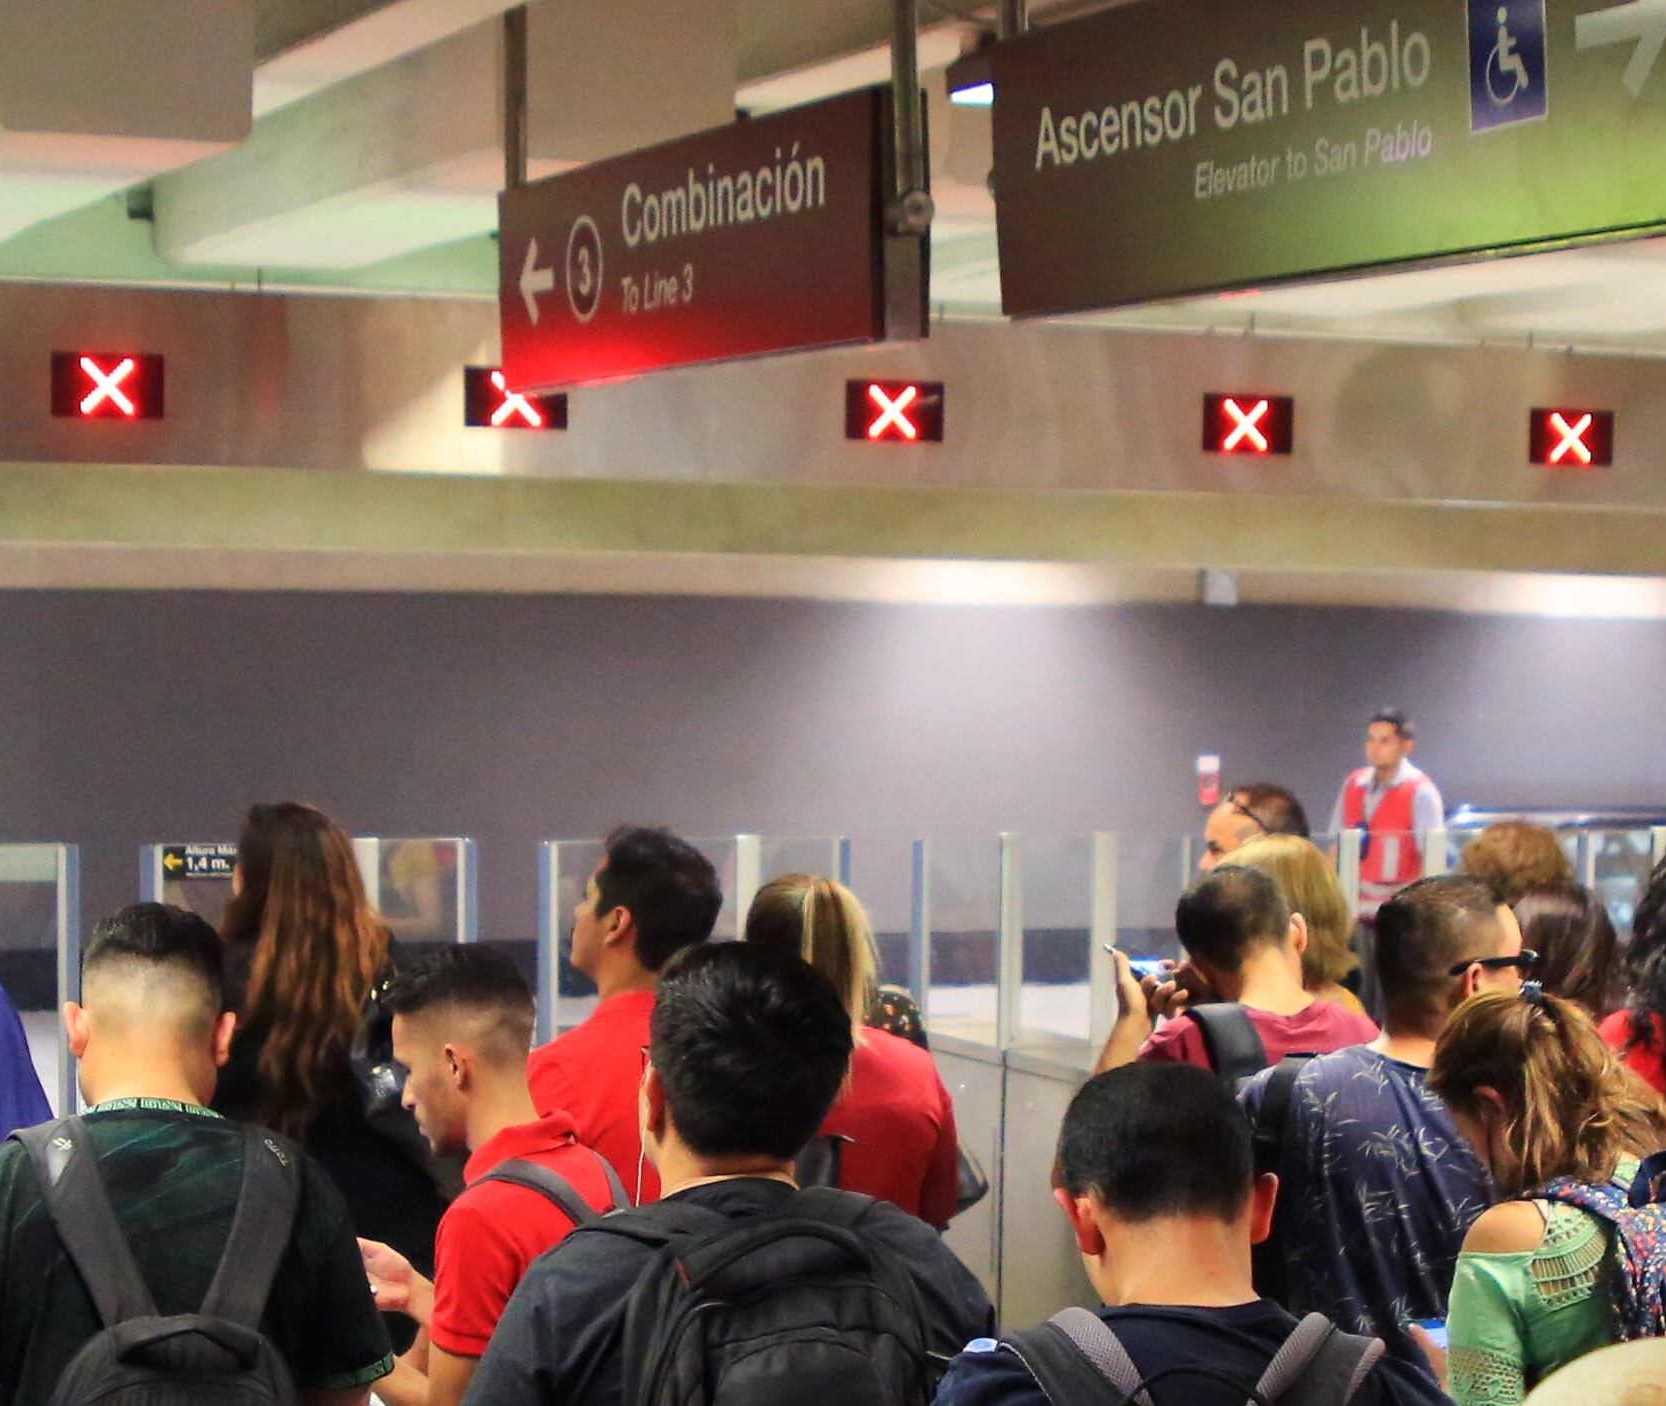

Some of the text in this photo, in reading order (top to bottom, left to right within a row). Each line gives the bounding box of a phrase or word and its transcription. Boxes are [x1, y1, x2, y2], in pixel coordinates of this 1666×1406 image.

[1035, 19, 1431, 170] Ascensor San Pablo
[1194, 119, 1433, 200] Elevator to San Pablo
[622, 142, 826, 247] Combinación
[576, 247, 593, 296] 3
[621, 263, 695, 315] To Line 3
[187, 856, 208, 872] 1,4
